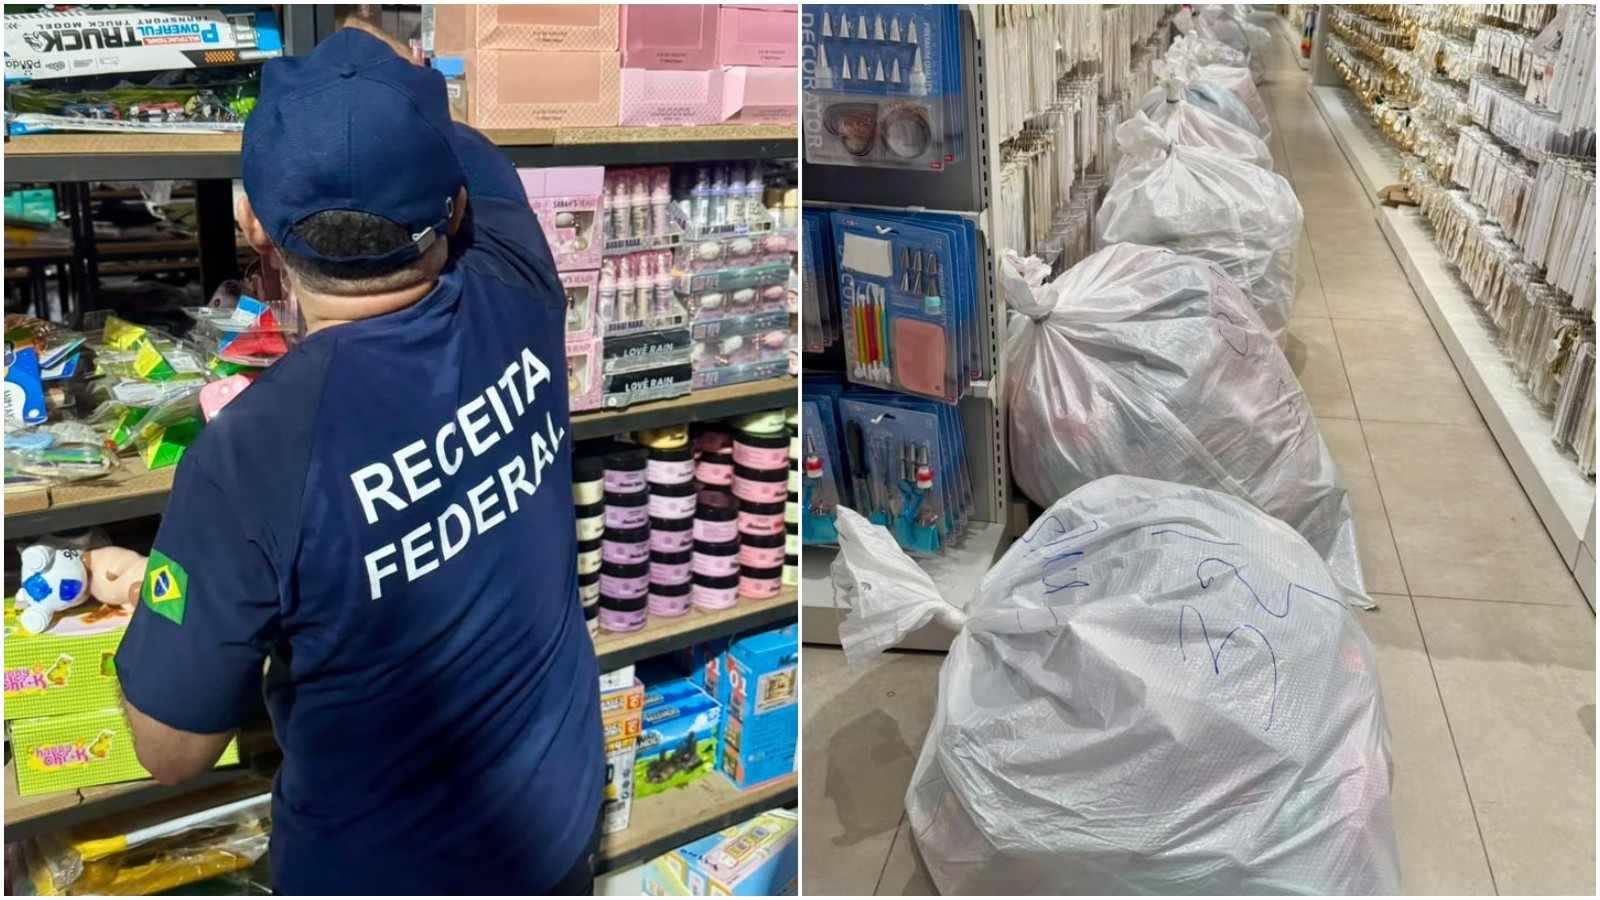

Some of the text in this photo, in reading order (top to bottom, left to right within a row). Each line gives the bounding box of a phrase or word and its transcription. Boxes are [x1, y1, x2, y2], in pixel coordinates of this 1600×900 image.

[37, 16, 208, 31] TRANSPORT TRUCK MODEL
[41, 23, 220, 53] POWERFUL TRUCK
[802, 13, 823, 148] DECORATOR
[649, 342, 674, 354] RAIN
[650, 376, 674, 389] RAIN
[350, 347, 551, 525] RECEITA
[364, 411, 565, 601] FEDERAL
